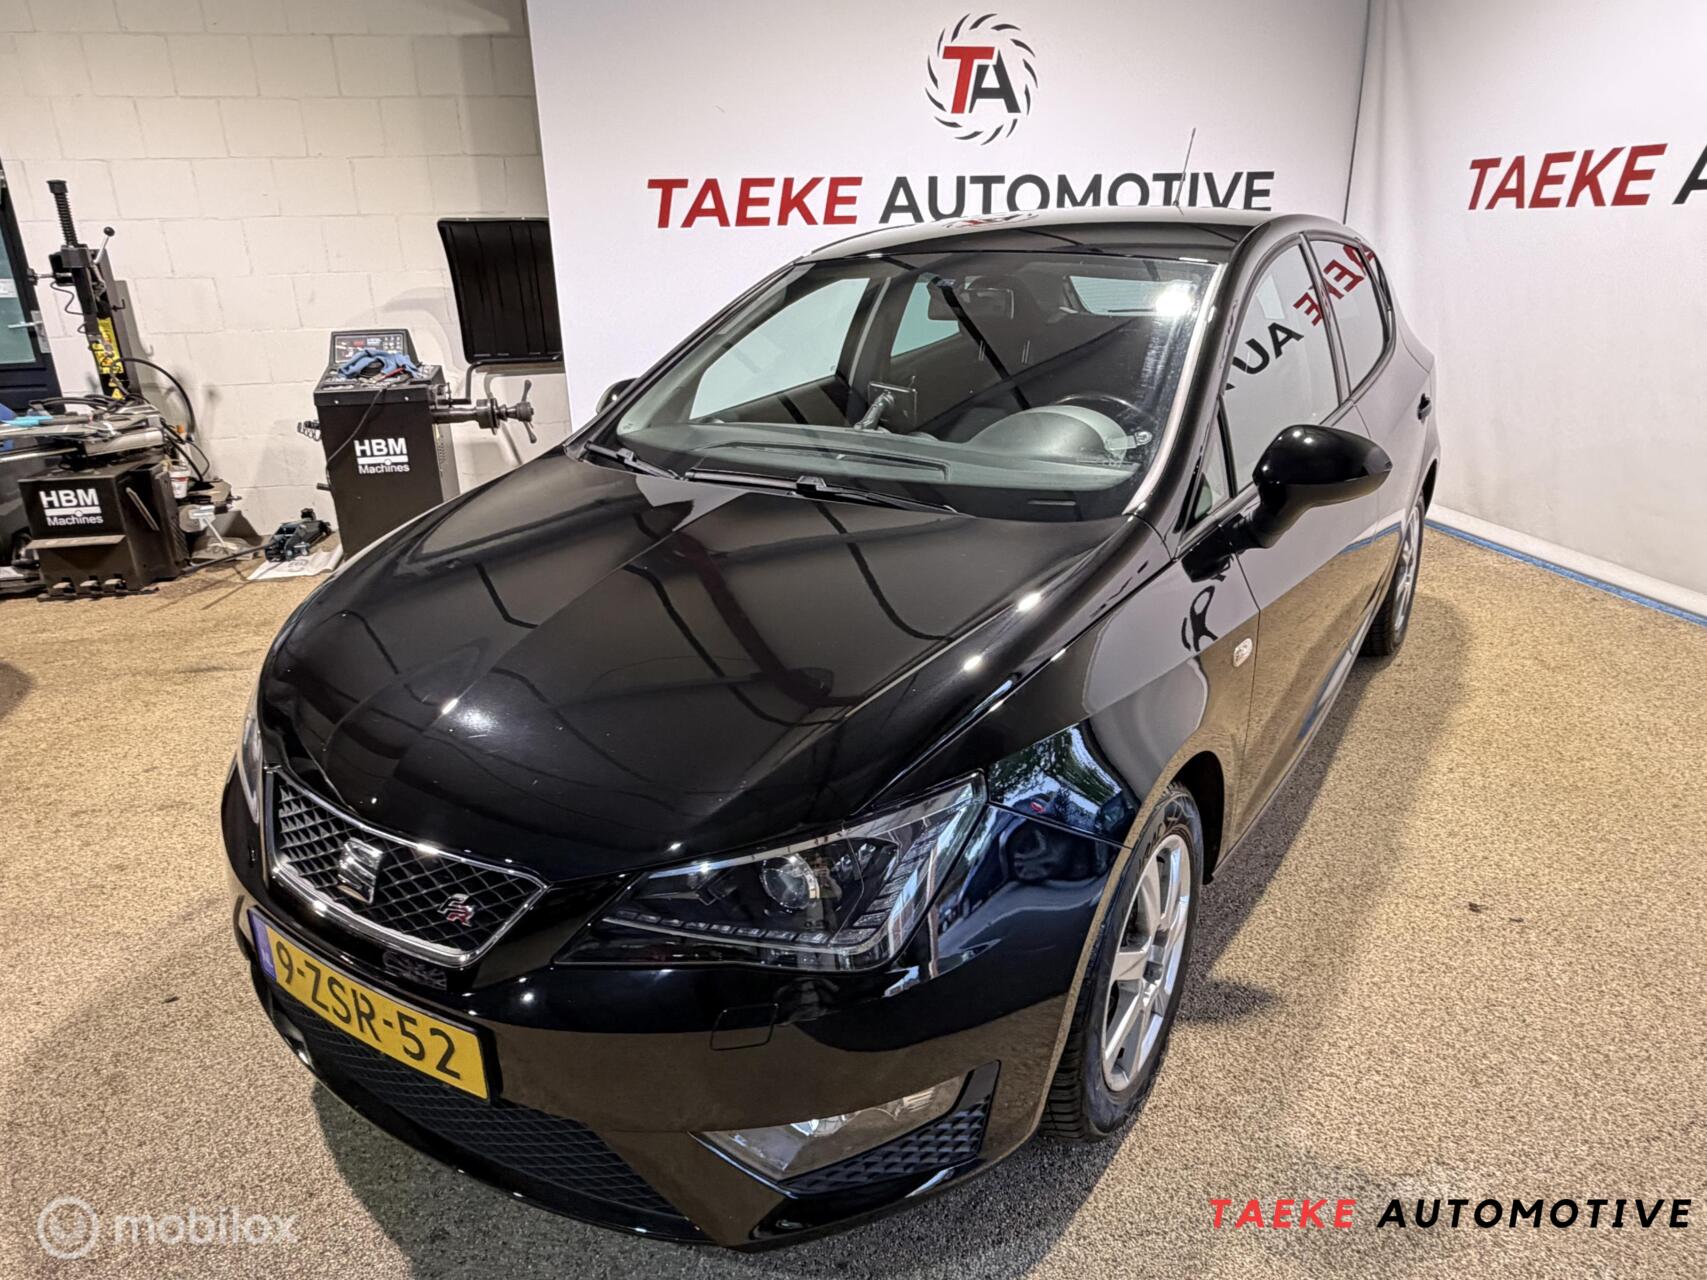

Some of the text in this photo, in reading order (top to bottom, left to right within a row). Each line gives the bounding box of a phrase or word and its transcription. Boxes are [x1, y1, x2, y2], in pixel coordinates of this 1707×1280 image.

[942, 45, 1022, 114] TA
[1467, 143, 1669, 211] TAEKE
[647, 171, 1275, 228] TAEKE AUTOMOTIVE
[354, 437, 408, 457] HBM
[357, 463, 410, 474] Machines
[39, 488, 99, 508] HBM
[46, 515, 104, 526] Machines
[275, 940, 461, 1080] 9-ZSR-52
